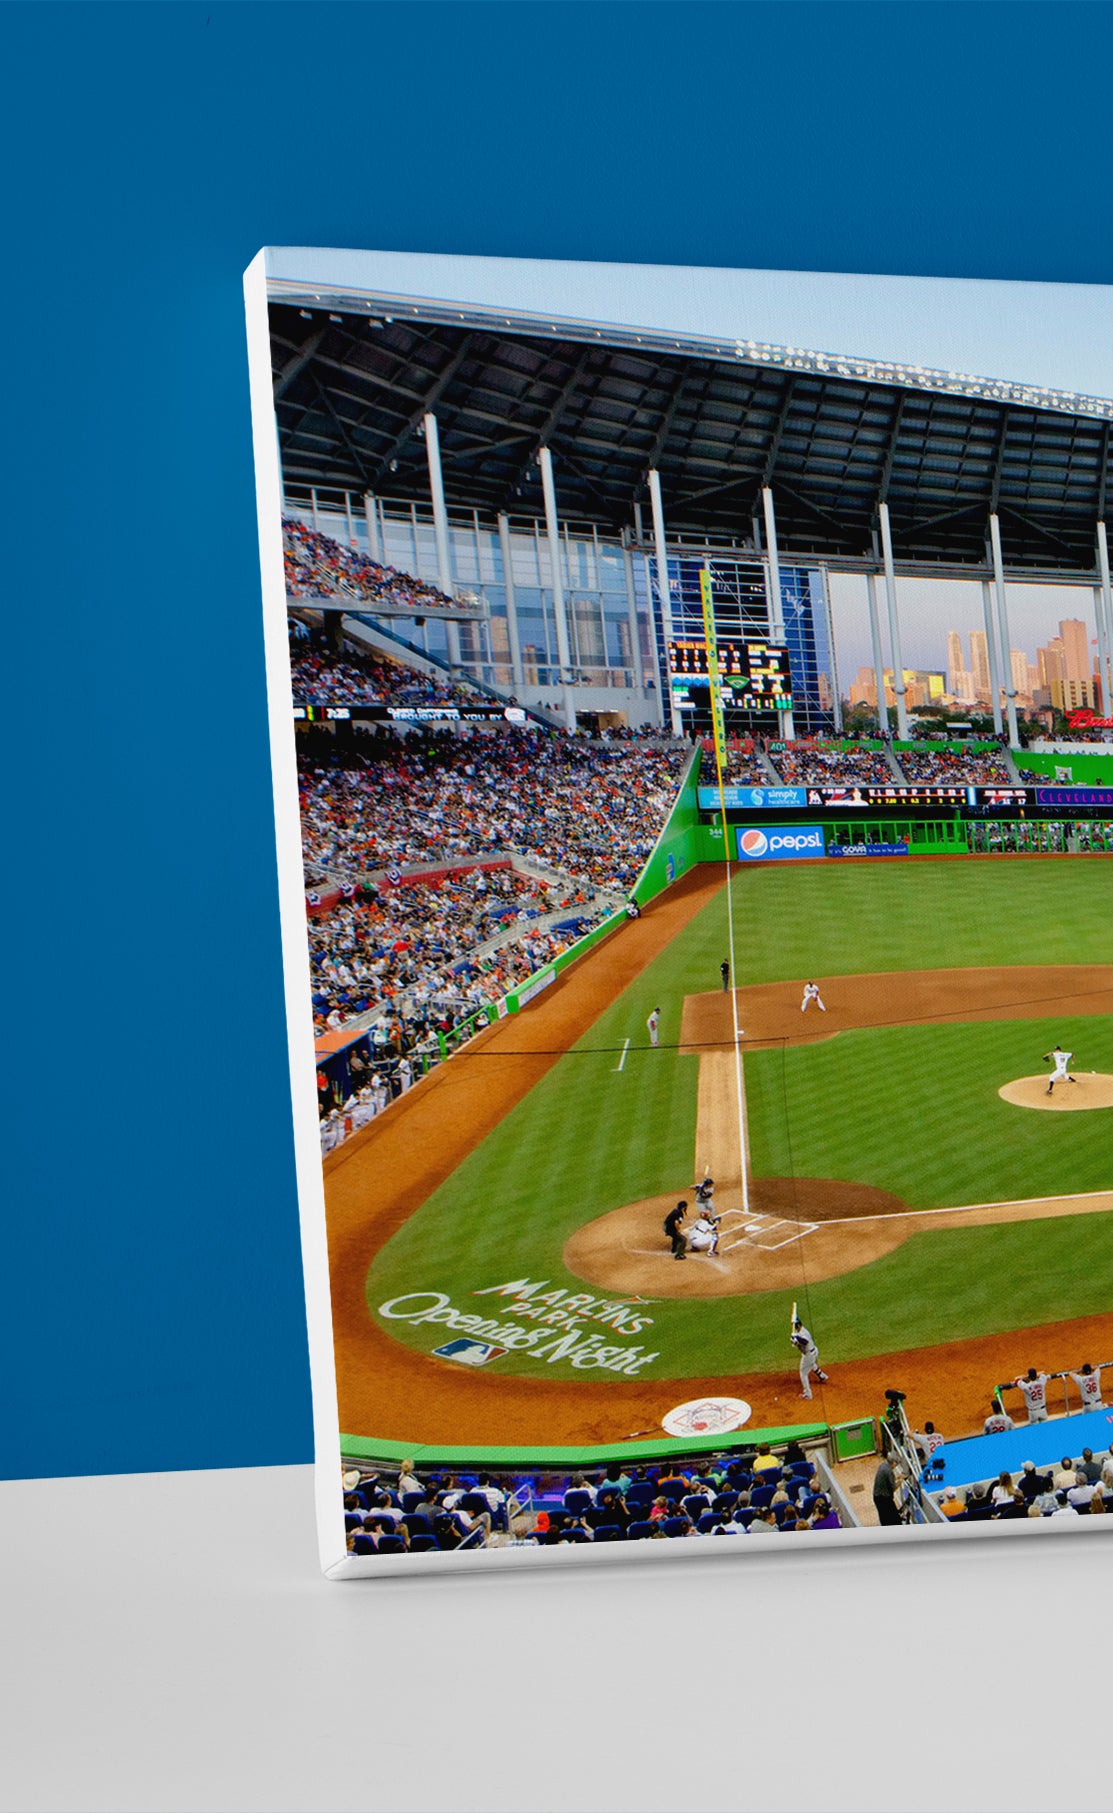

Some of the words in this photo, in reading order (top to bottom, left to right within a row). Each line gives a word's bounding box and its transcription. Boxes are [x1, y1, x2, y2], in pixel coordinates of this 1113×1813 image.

[463, 713, 486, 721] YOU
[768, 790, 797, 800] simply
[769, 832, 823, 852] pepsi
[471, 1278, 654, 1336] MARLINS
[500, 1298, 588, 1331] PARK
[378, 1292, 558, 1350] Opening
[527, 1328, 660, 1375] Night
[1031, 1390, 1043, 1401] 25
[1085, 1382, 1097, 1394] 36
